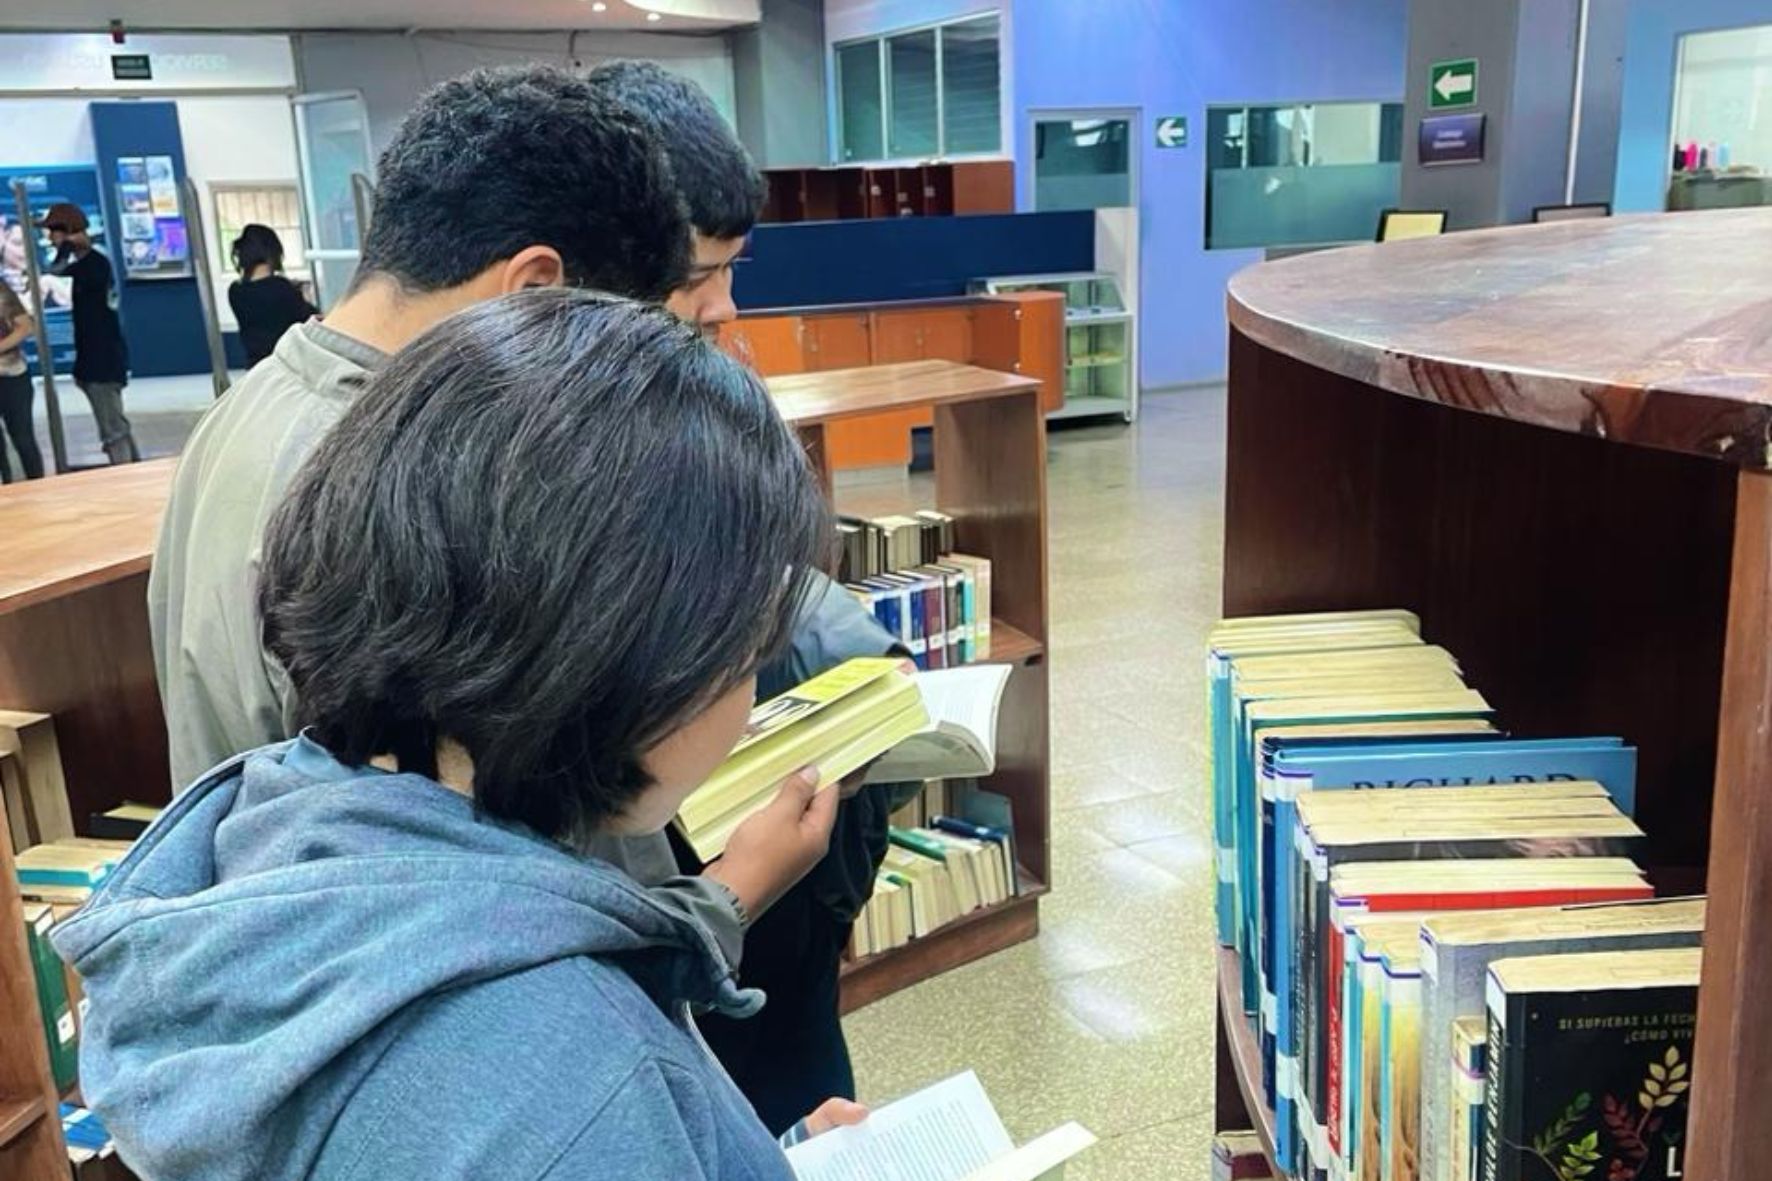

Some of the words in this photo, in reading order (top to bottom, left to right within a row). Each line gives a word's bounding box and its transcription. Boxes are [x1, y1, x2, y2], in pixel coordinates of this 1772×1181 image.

[1643, 1014, 1659, 1026] LA
[1487, 1018, 1500, 1129] BENJAMIN
[1485, 1127, 1497, 1181] HLOE
